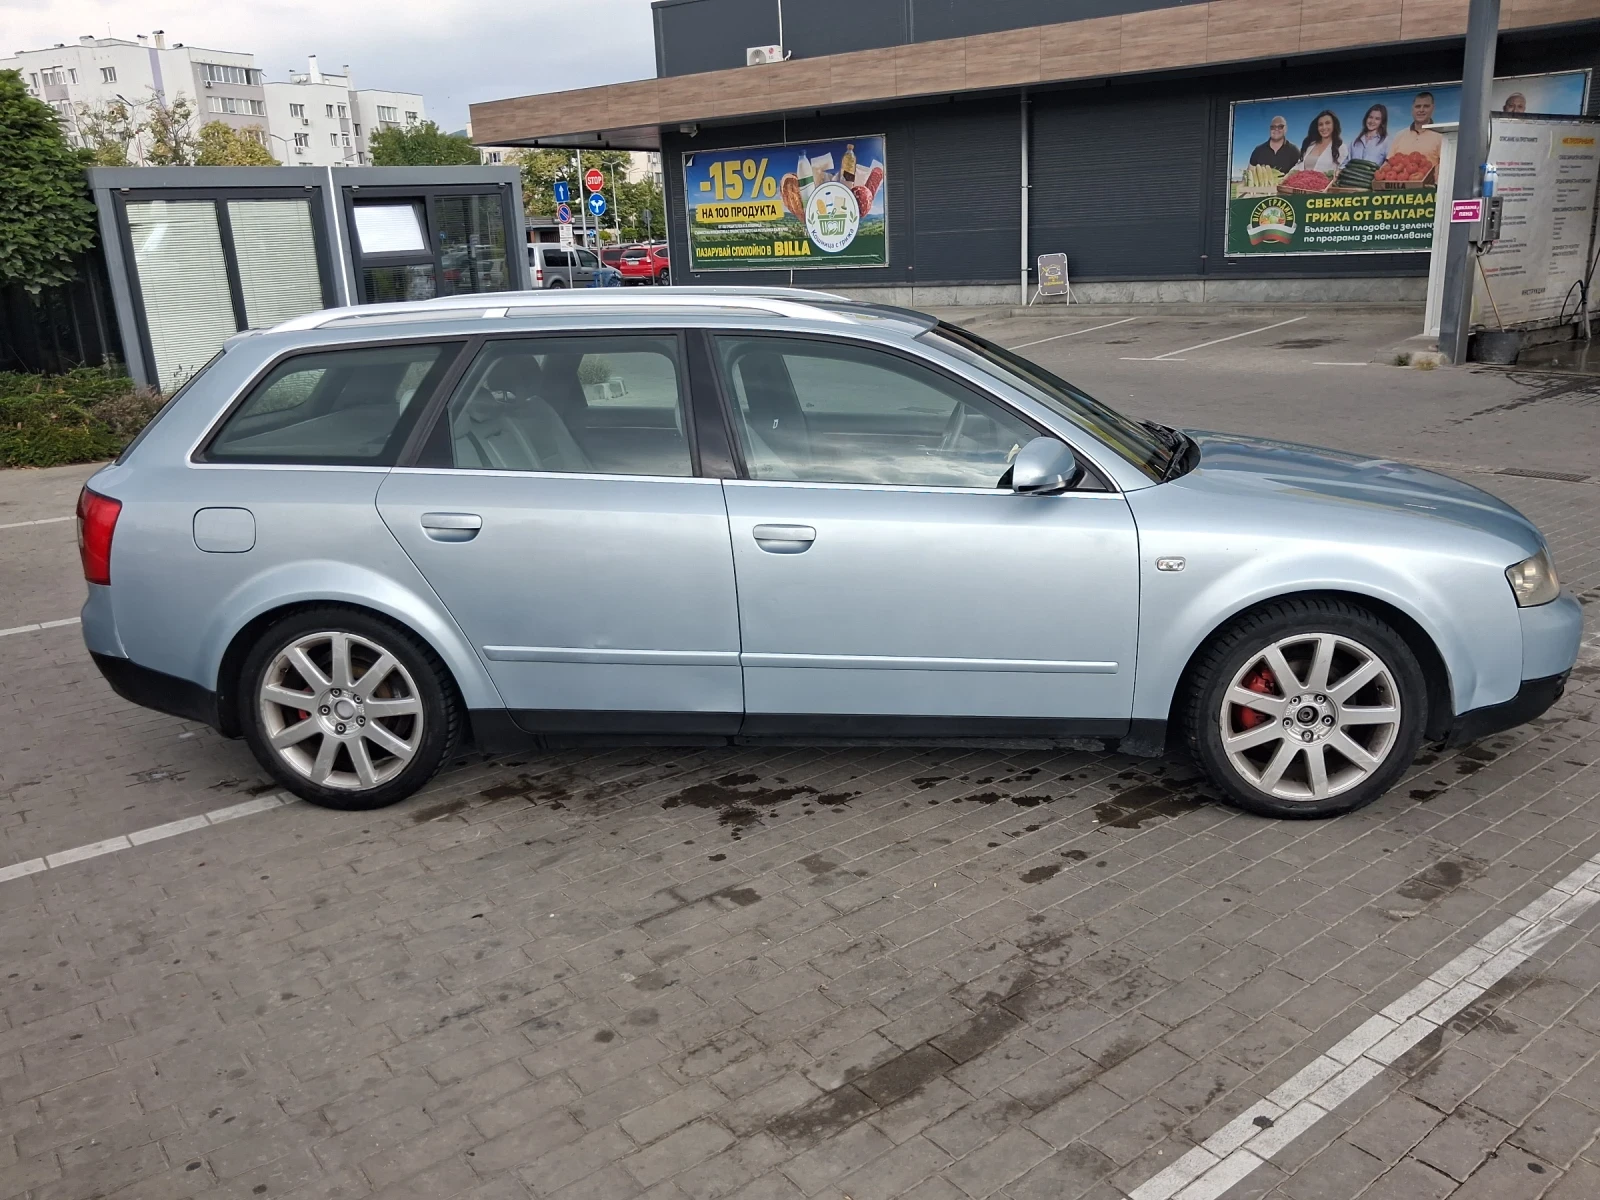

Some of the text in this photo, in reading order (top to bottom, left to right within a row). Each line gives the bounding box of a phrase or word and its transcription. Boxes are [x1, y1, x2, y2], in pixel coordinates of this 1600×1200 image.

[587, 176, 602, 185] STOP
[700, 158, 777, 200] -15%
[1306, 196, 1369, 209] СВЕЖЕСТ
[702, 204, 777, 218] НА 100 ПРОДУКТА
[1305, 208, 1434, 223] ГРИЖА ОТ БЪЛГАРС
[1304, 224, 1350, 233] Български
[1352, 222, 1390, 232] плодове
[1316, 235, 1360, 243] програма
[1361, 234, 1372, 242] за
[1374, 231, 1432, 240] намаляване
[696, 240, 811, 257] ПАЗАРУВАЙ СПОКОЙНО В BILLA
